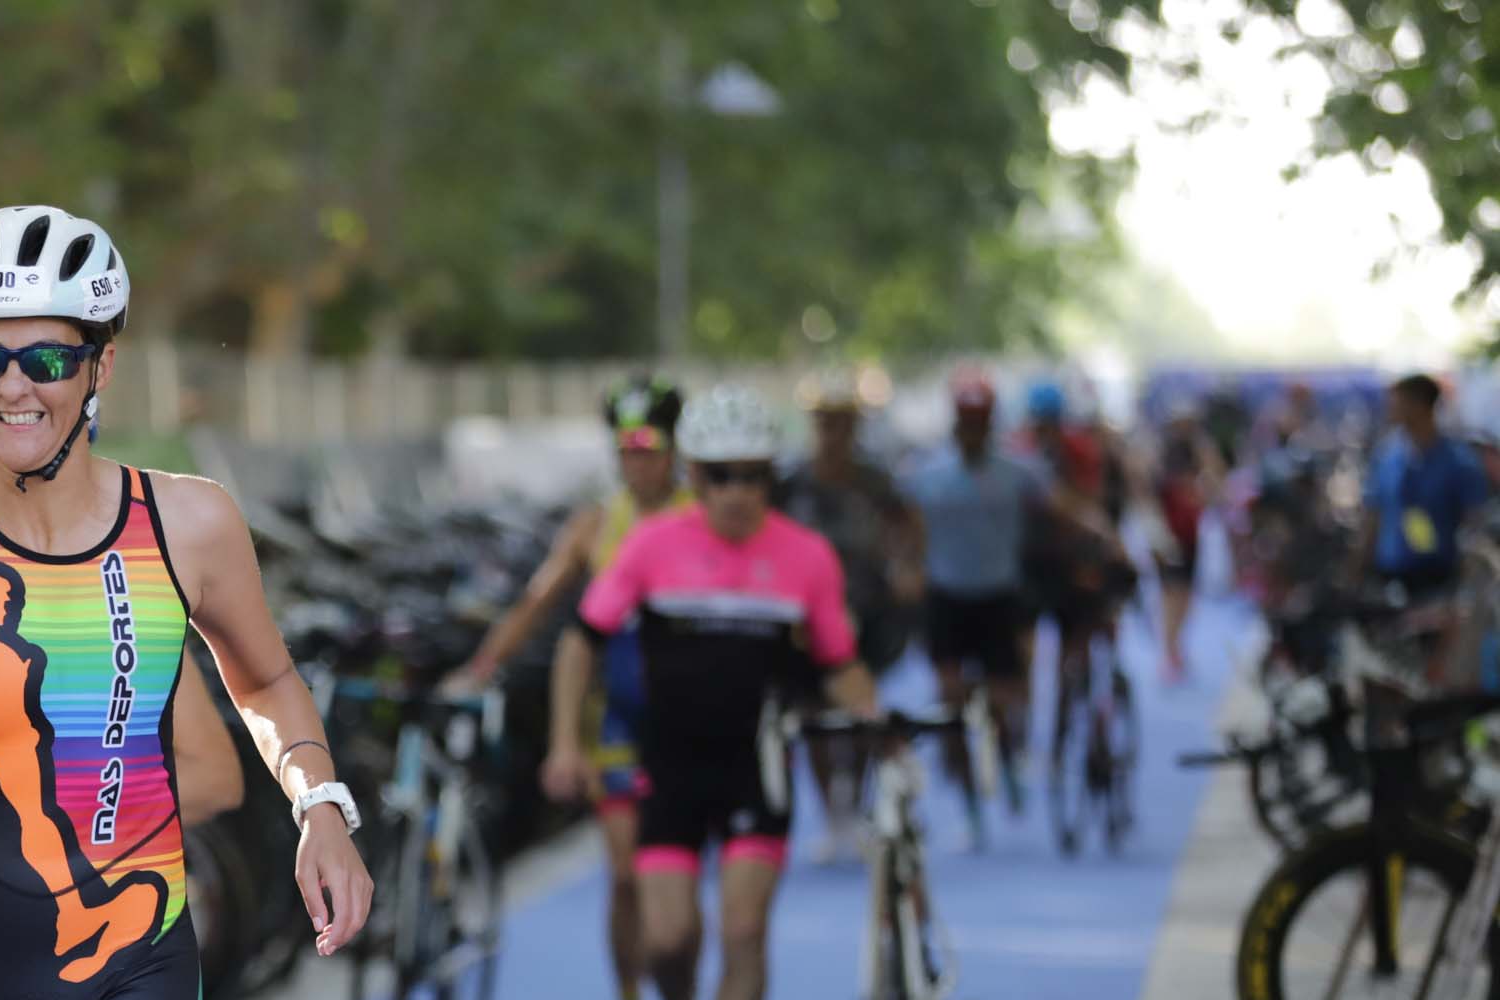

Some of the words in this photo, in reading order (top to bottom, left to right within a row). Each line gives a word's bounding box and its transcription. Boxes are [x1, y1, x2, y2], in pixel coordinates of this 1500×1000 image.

[92, 277, 113, 298] 690
[102, 551, 135, 746] DEPORTES
[94, 759, 121, 842] MAS
